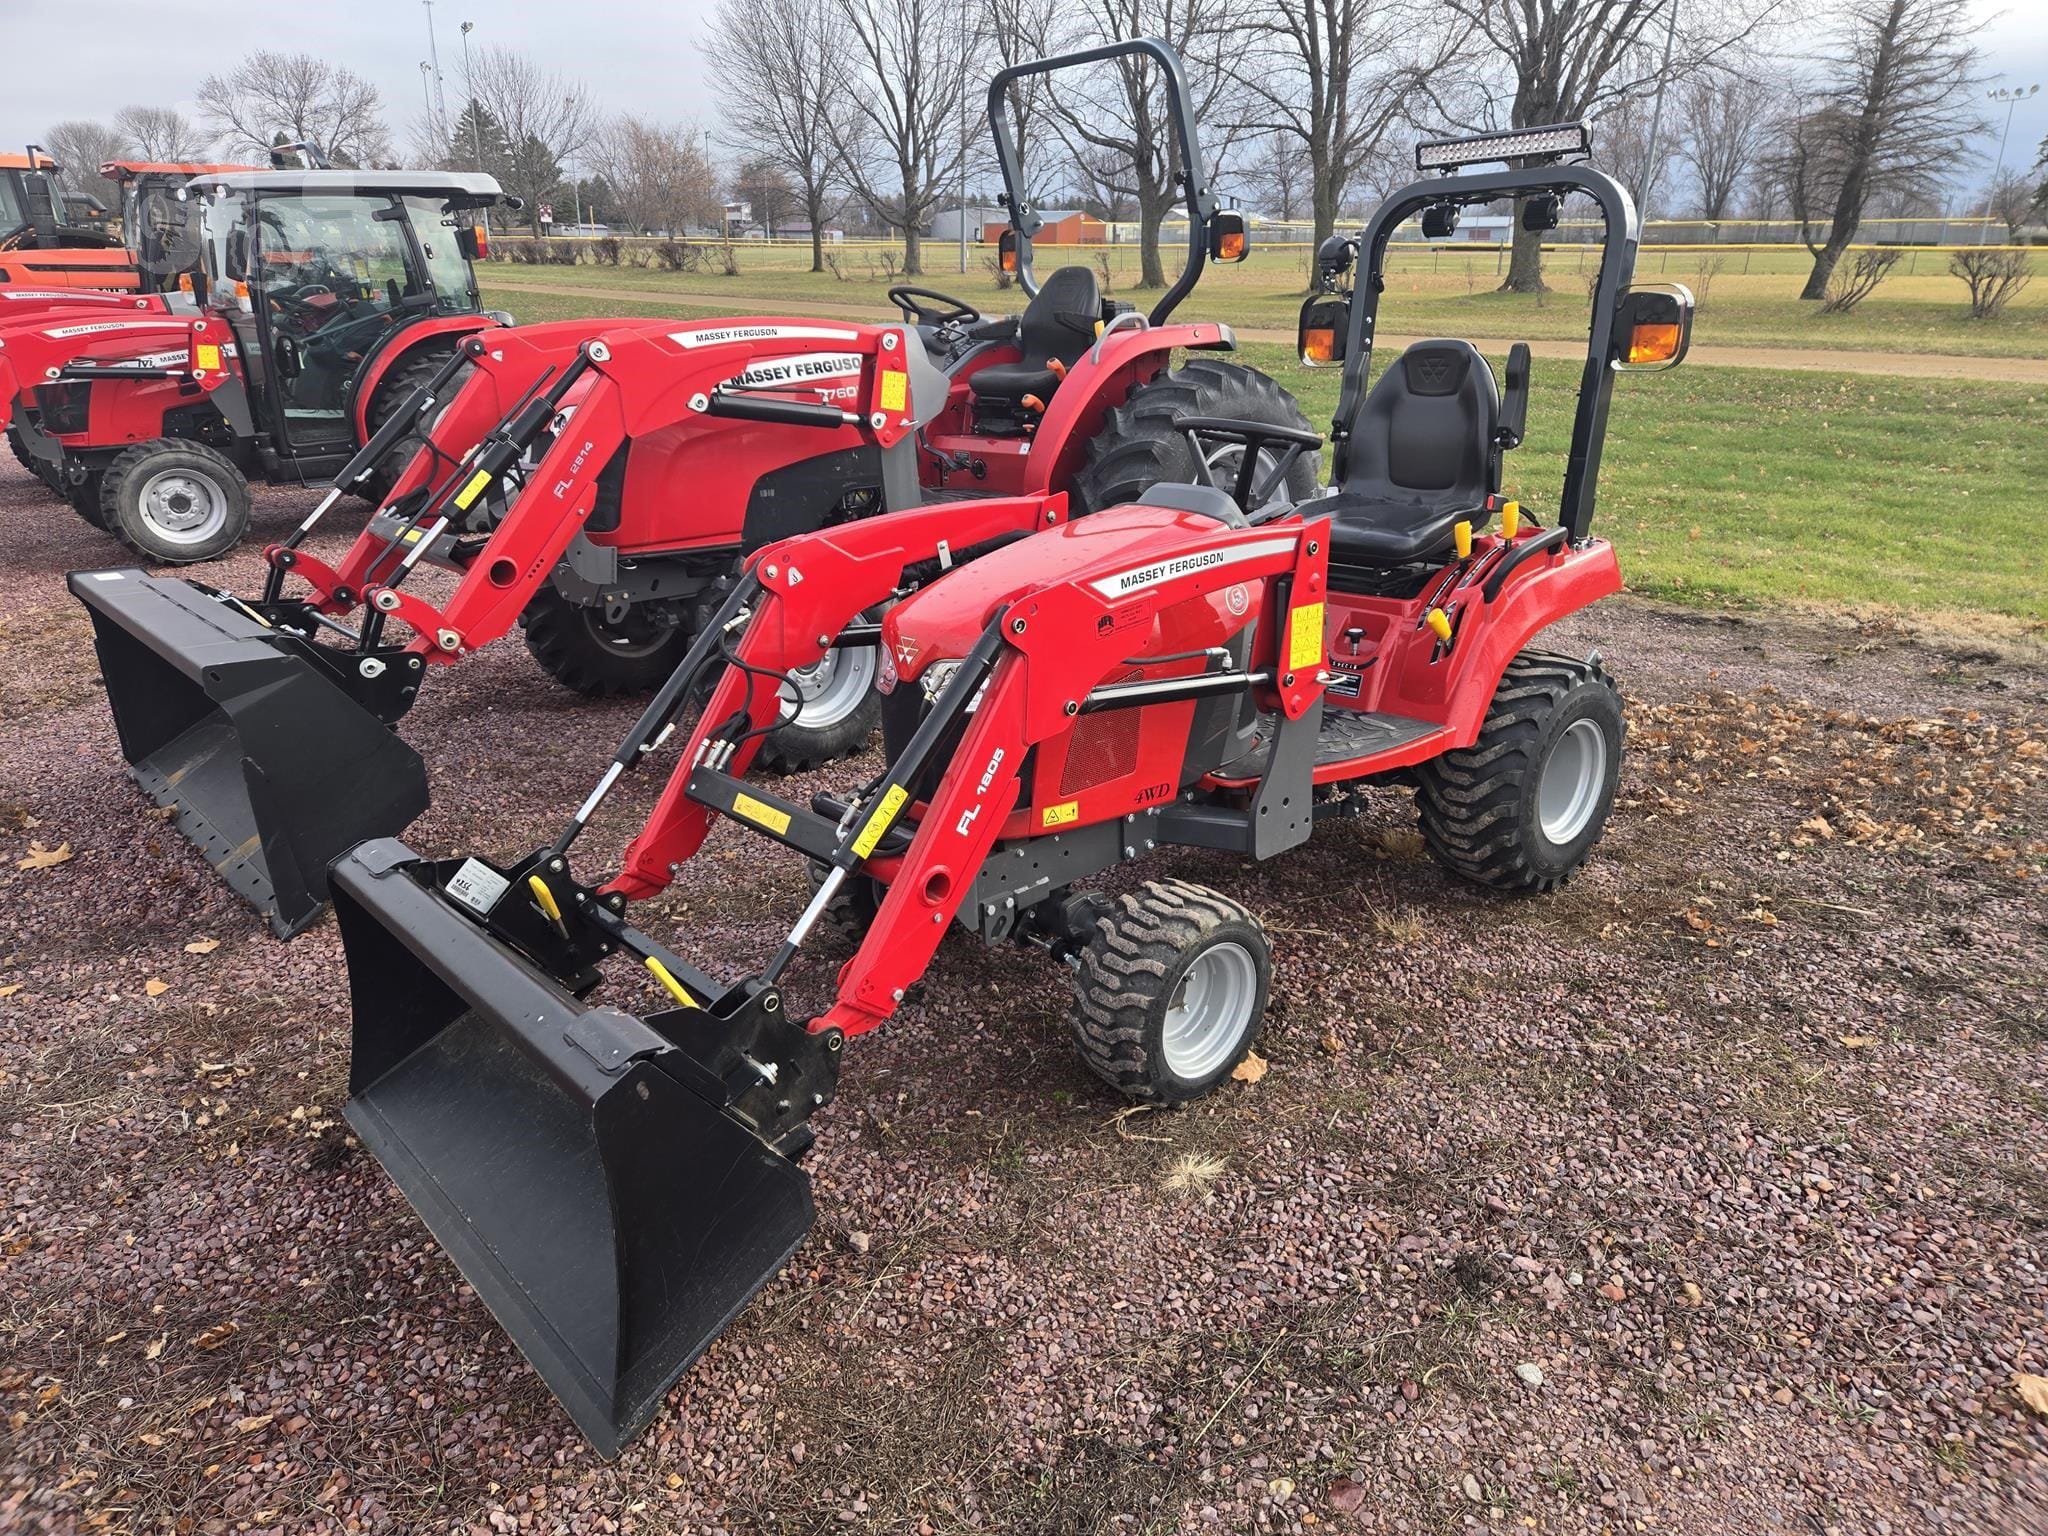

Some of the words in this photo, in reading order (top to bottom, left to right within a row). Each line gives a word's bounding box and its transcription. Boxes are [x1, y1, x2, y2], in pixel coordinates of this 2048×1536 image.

[90, 323, 125, 331] FERGUSON
[696, 331, 732, 342] MASSEY
[734, 328, 778, 338] FERGUSON
[730, 366, 791, 386] MASSEY
[795, 357, 861, 378] FERGUSO
[553, 479, 574, 499] FL
[570, 441, 594, 474] 2814
[1120, 566, 1166, 590] MASSEY
[1169, 551, 1224, 575] FERGUSON
[956, 803, 982, 837] FL
[976, 747, 1005, 796] 1805
[1135, 783, 1170, 804] 4WD
